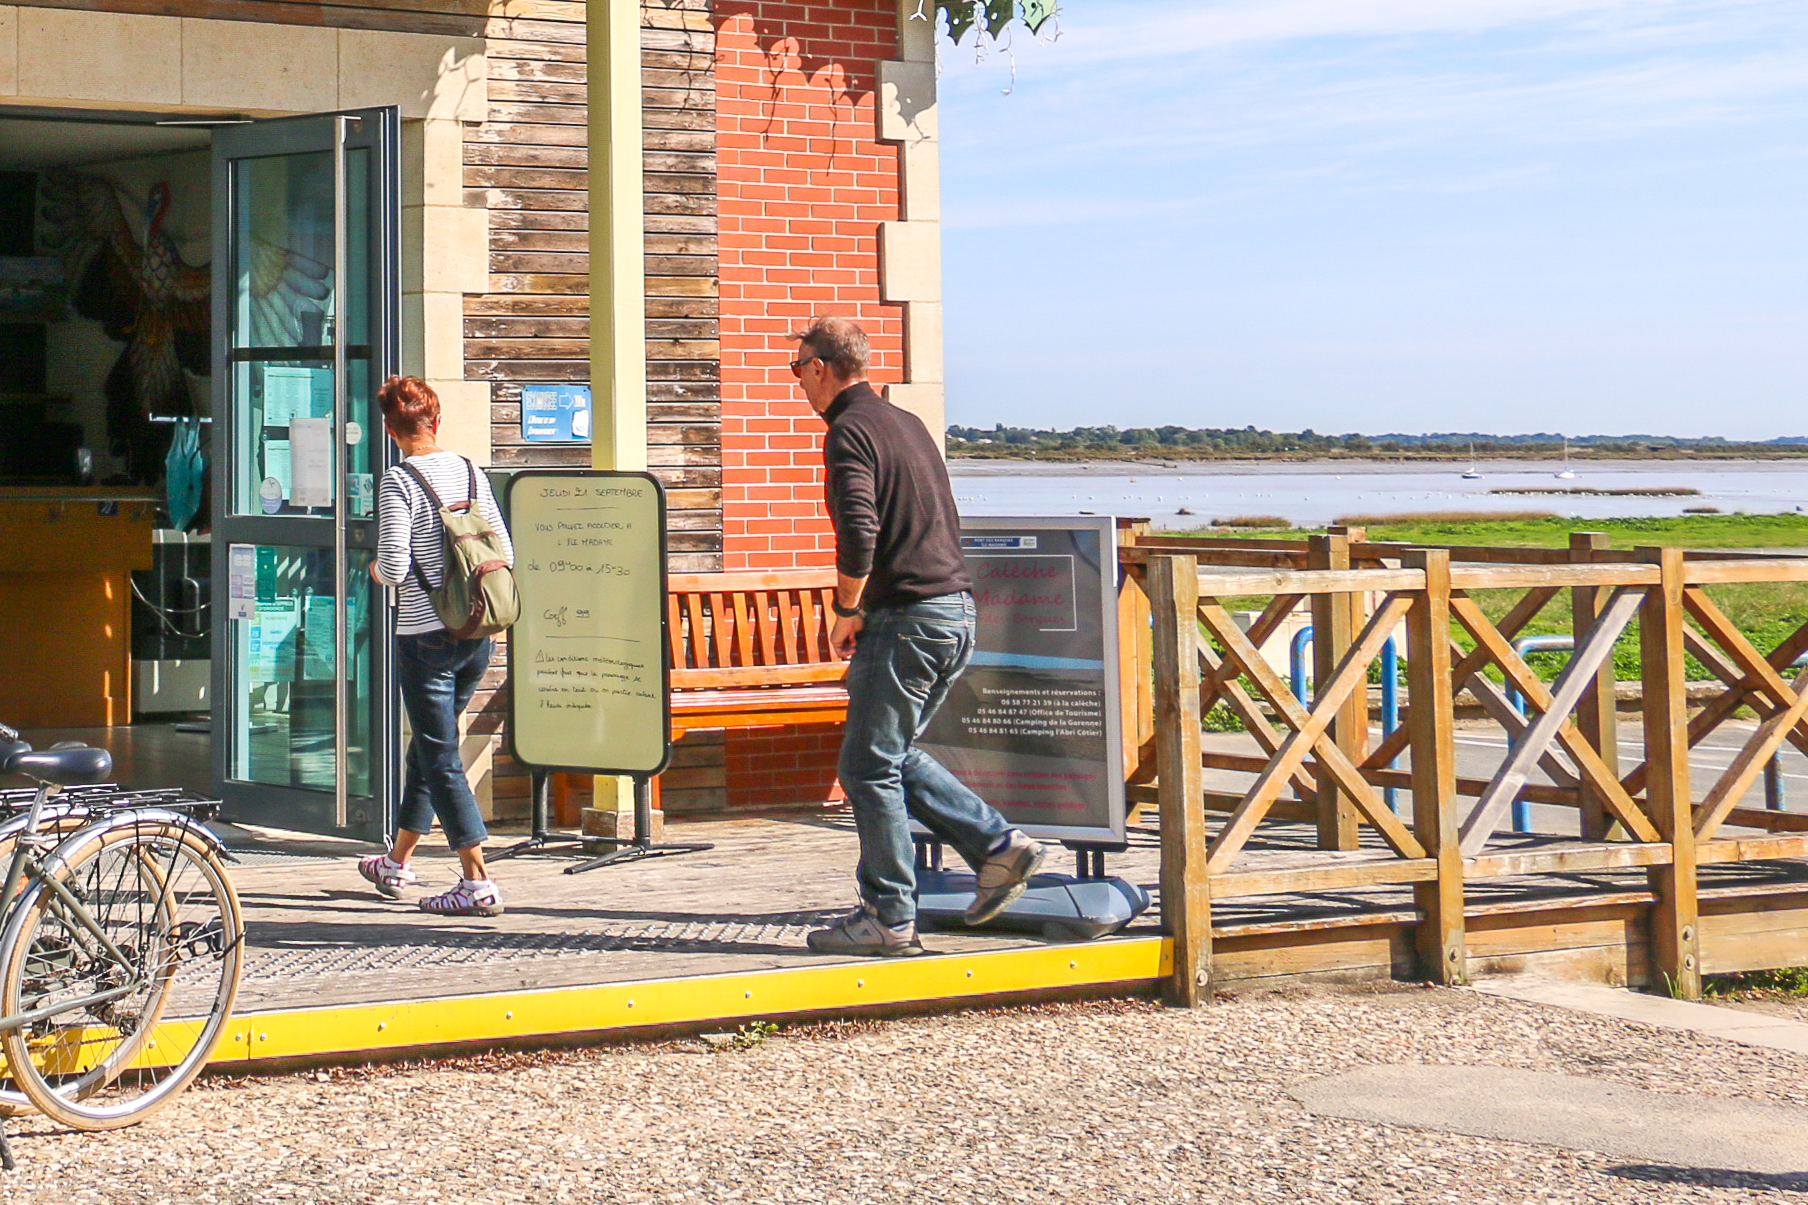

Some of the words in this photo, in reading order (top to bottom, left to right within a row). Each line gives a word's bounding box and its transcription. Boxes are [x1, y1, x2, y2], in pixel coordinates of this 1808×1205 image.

[574, 487, 587, 497] 21
[595, 487, 643, 498] SEPTEMBRE
[582, 539, 613, 547] MADAME
[528, 559, 540, 571] de
[977, 560, 1058, 580] Calèche
[973, 589, 1065, 607] Madame
[982, 688, 1040, 696] Renseignements
[1065, 709, 1102, 717] Tourisme)
[1013, 718, 1047, 726] (Camping
[1067, 719, 1102, 727] Garenne)
[1020, 728, 1054, 737] (Camping
[1076, 729, 1102, 737] Côtier)
